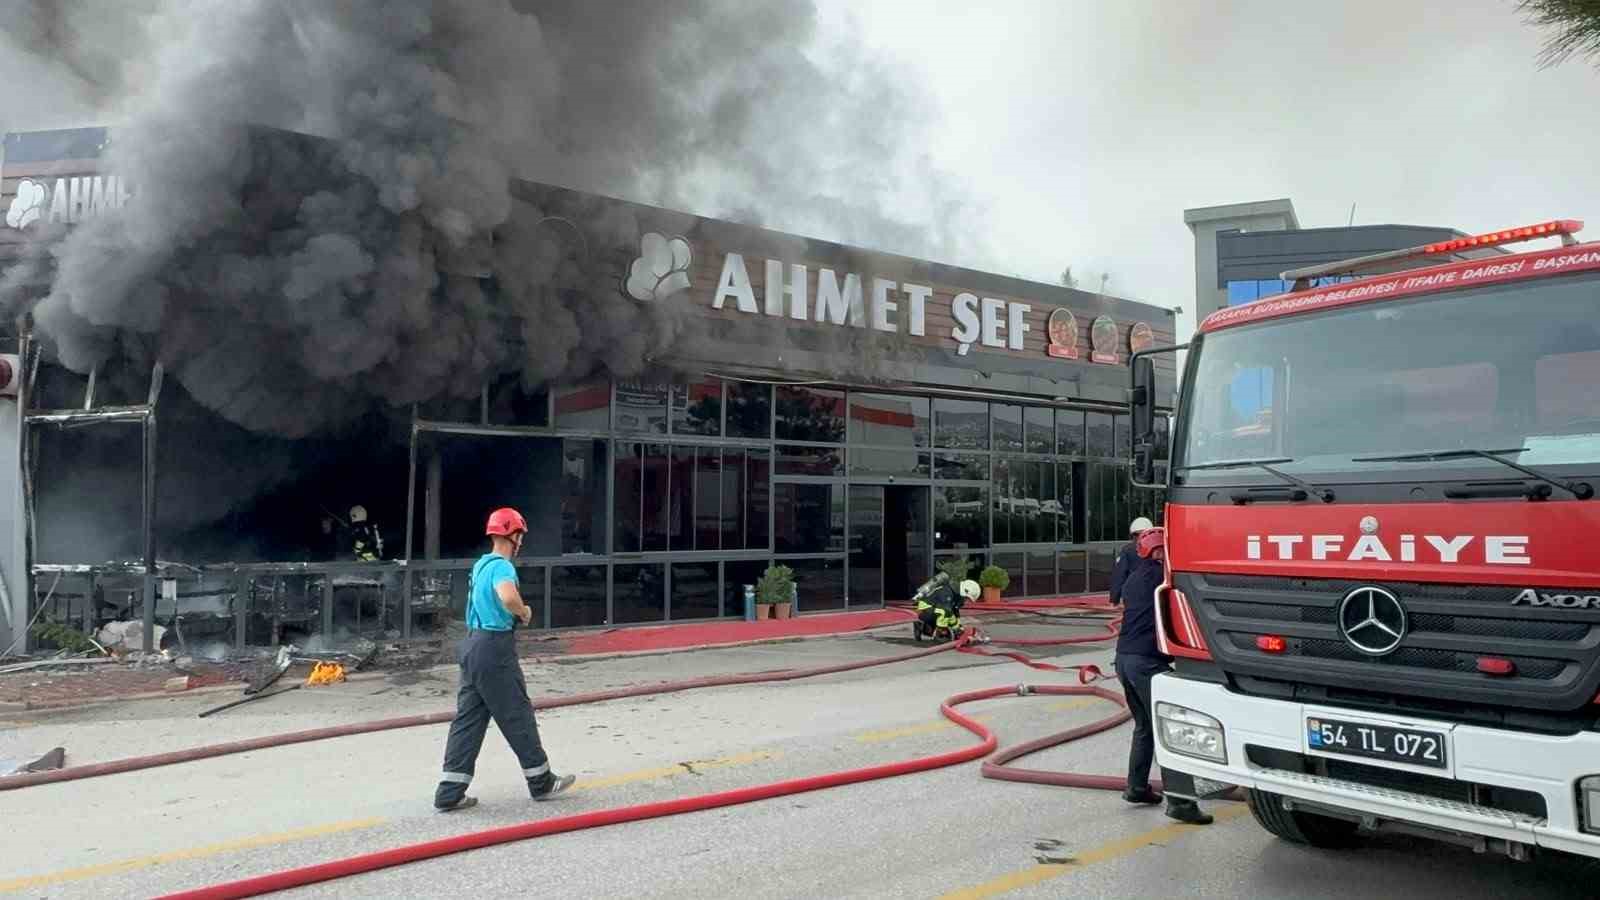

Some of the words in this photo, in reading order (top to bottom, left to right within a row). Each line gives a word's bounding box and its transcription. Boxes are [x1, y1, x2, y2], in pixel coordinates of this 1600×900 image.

[711, 252, 932, 337] AHMET
[951, 291, 1032, 356] ŞEF
[1320, 723, 1347, 747] 54
[1357, 728, 1386, 752] TL
[1394, 732, 1438, 760] 072
